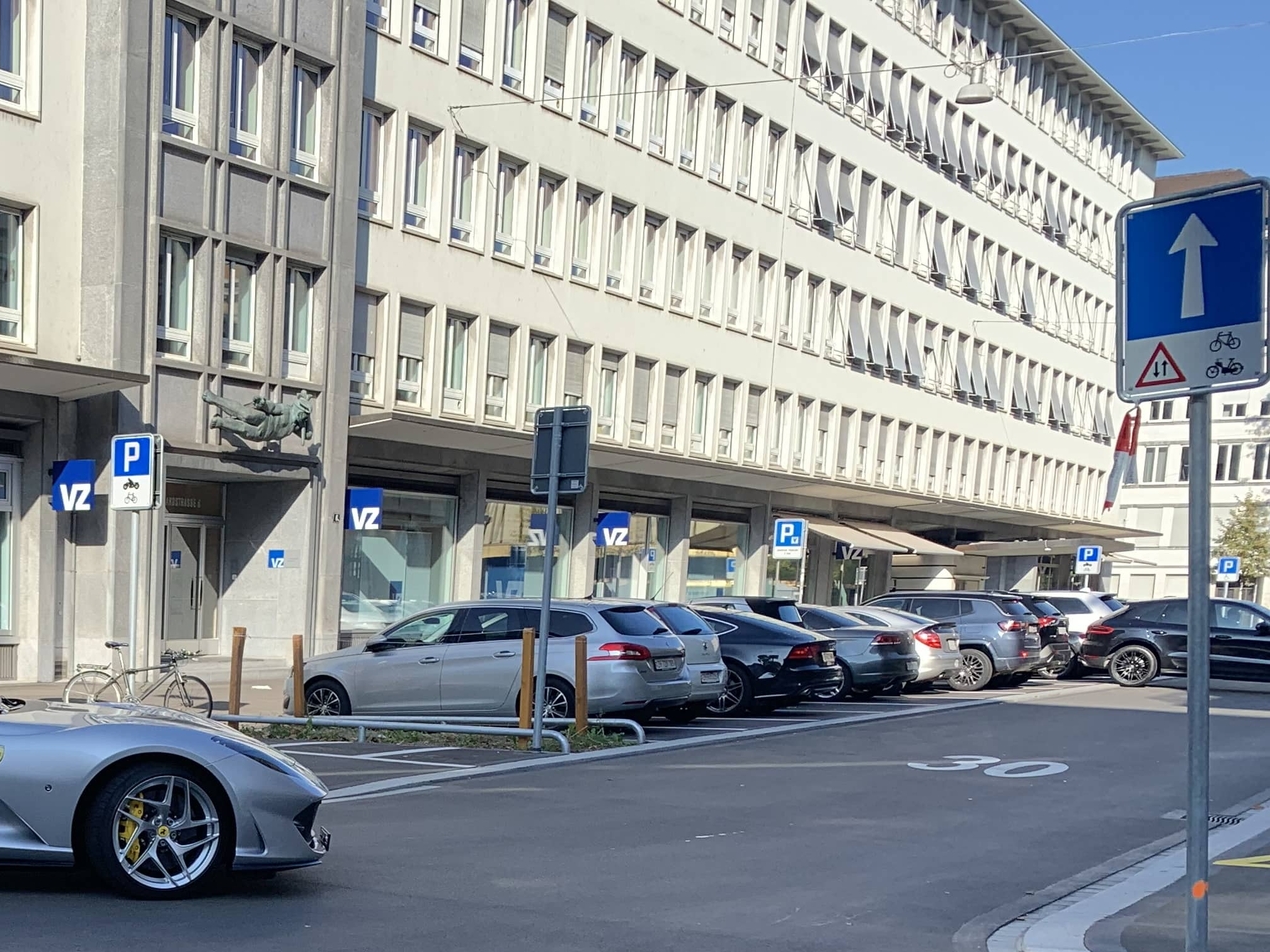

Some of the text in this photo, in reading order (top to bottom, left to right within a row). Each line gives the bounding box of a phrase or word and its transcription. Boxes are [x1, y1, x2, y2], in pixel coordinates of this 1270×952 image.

[123, 441, 140, 473] P
[59, 483, 91, 511] VZ
[350, 507, 380, 530] VZ
[602, 528, 629, 546] VZ
[780, 523, 795, 543] P
[841, 546, 864, 560] VZ
[1084, 548, 1094, 561] P
[271, 558, 285, 568] VZ
[1223, 560, 1234, 573] P
[906, 754, 1070, 778] 30
